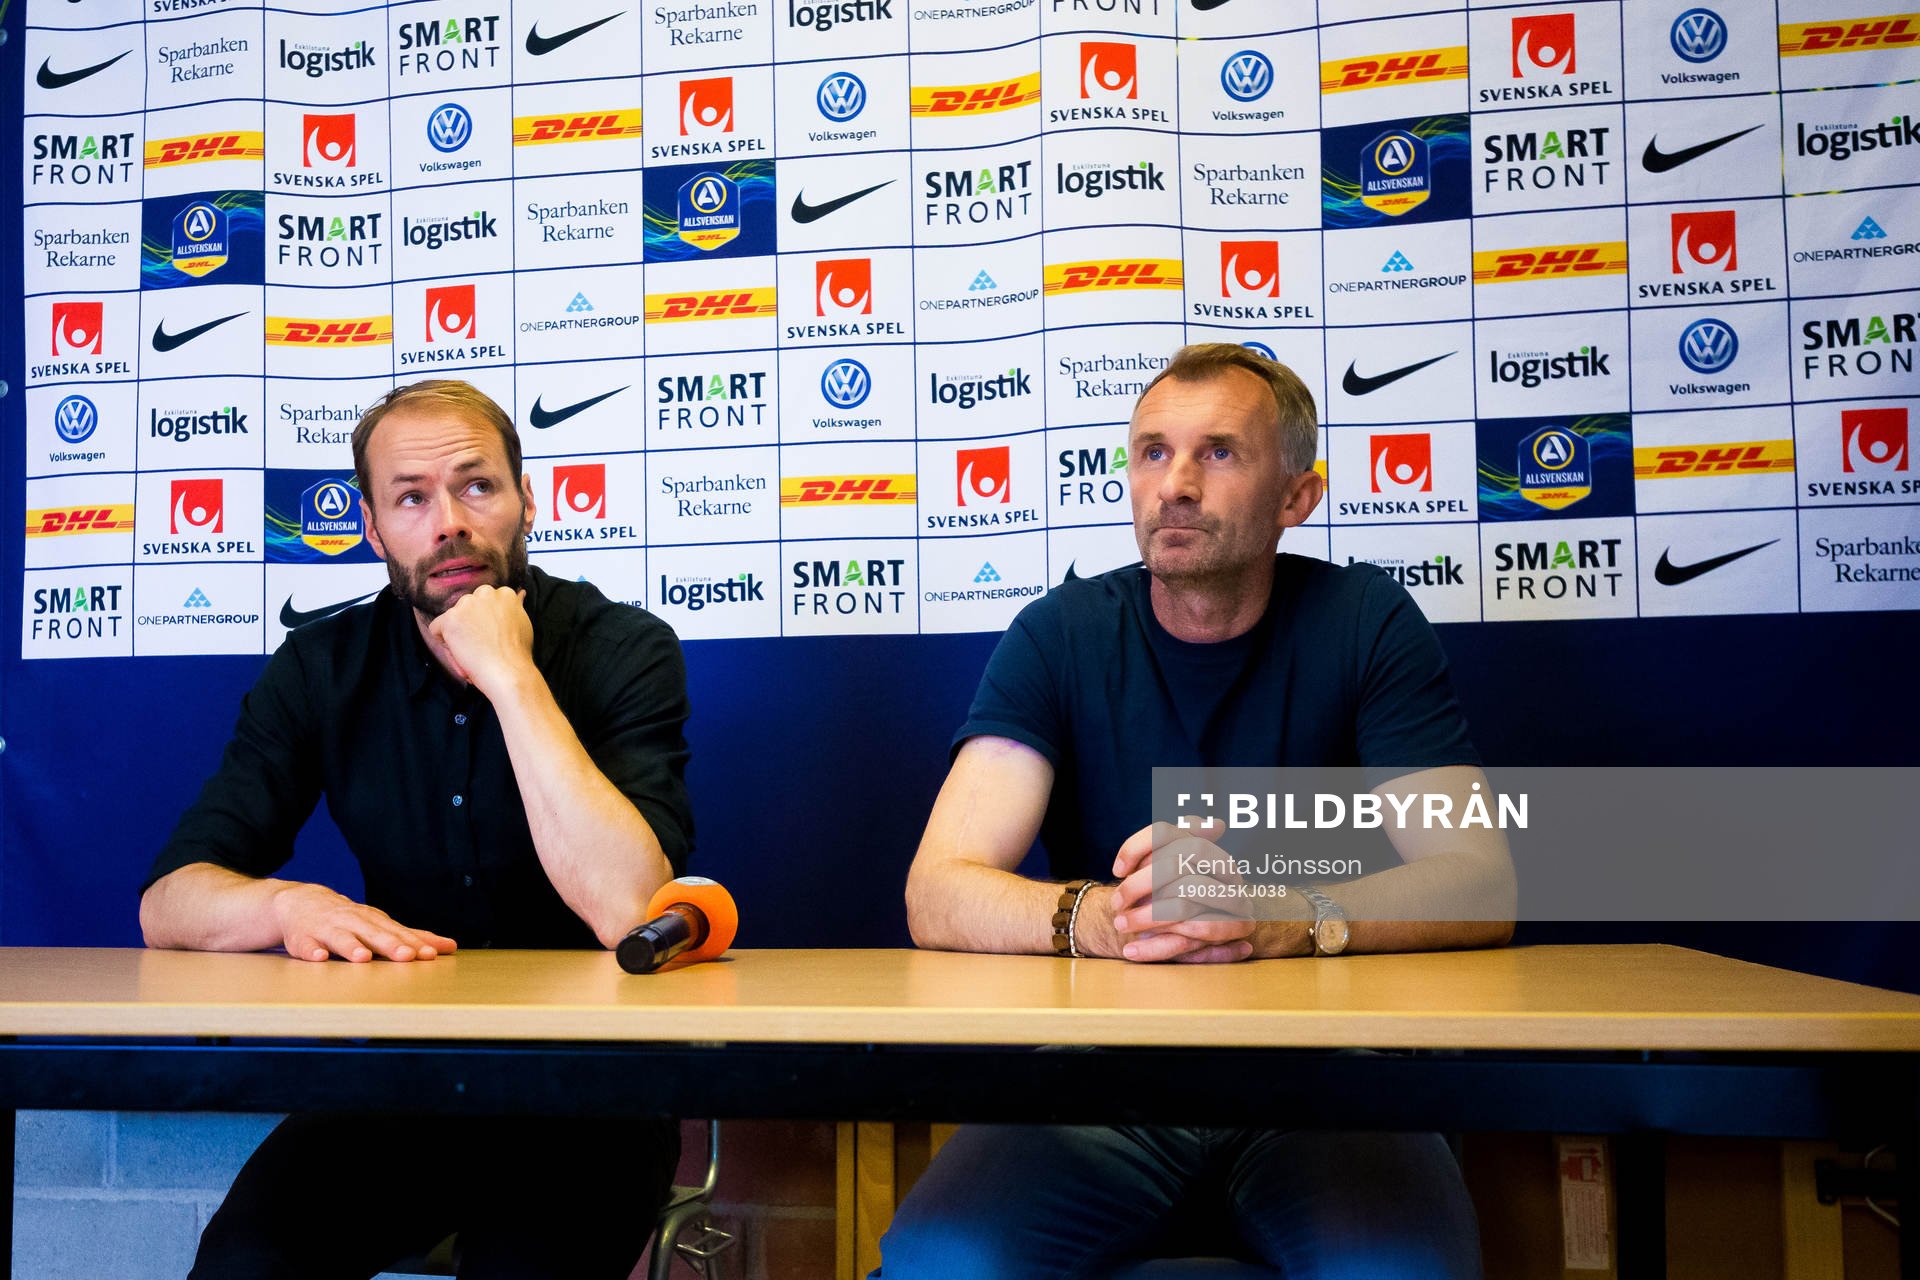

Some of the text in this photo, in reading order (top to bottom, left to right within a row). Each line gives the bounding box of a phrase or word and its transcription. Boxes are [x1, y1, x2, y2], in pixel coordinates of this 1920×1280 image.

[656, 2, 757, 28] Sparbanken
[399, 16, 499, 50] SMART
[671, 28, 742, 46] Rekarne
[1802, 20, 1917, 49] DHL
[159, 38, 247, 66] Sparbanken
[280, 39, 375, 77] logistik
[400, 47, 499, 76] FRONT
[171, 63, 233, 83] Rekarne
[1342, 55, 1445, 86] DHL
[1661, 73, 1740, 83] Volkswagen
[931, 84, 1024, 111] DHL
[1480, 81, 1612, 102] SVENSKA SPEL
[1051, 107, 1168, 122] SVENSKA SPEL
[1213, 111, 1284, 121] Volkswagen
[533, 116, 624, 140] DHL
[809, 131, 876, 141] Volkswagen
[1797, 115, 1920, 160] logistik
[34, 133, 134, 160] SMART
[159, 136, 245, 163] DHL
[652, 139, 765, 158] SVENSKA SPEL
[1484, 128, 1609, 163] SMART
[33, 162, 133, 184] FRONT
[420, 160, 481, 172] Volkswagen
[1194, 164, 1304, 186] Sparbanken
[274, 172, 383, 187] SVENSKA SPEL
[926, 161, 1032, 198] SMART
[1058, 162, 1165, 198] logistik
[1368, 176, 1424, 192] ALLSVENSKAN
[1486, 162, 1610, 193] FRONT
[1211, 188, 1288, 205] Rekarne
[528, 199, 628, 224] Sparbanken
[927, 191, 1031, 225] FRONT
[279, 213, 381, 241] SMART
[404, 211, 497, 249] logistik
[684, 214, 734, 228] ALLSVENSKAN
[35, 229, 129, 250] Sparbanken
[543, 225, 614, 242] Rekarne
[47, 251, 115, 267] Rekarne
[177, 242, 222, 256] ALLSVENSKAN
[279, 244, 382, 267] FRONT
[1496, 250, 1604, 277] DHL
[1063, 264, 1163, 288] DHL
[1330, 275, 1466, 292] ONEPARTNERGROUP
[1639, 278, 1776, 298] SVENSKA SPEL
[664, 294, 757, 318] DHL
[920, 289, 1038, 310] ONEPARTNERGROUP
[1194, 304, 1313, 318] SVENSKA SPEL
[284, 322, 377, 342] DHL
[520, 316, 639, 332] ONEPARTNERGROUP
[788, 323, 904, 338] SVENSKA SPEL
[401, 345, 505, 364] SVENSKA SPEL
[1059, 352, 1170, 379] Sparbanken
[1804, 349, 1913, 379] FRON
[32, 362, 130, 378] SVENSKA SPEL
[1491, 346, 1610, 388] logistik
[658, 372, 766, 403] SMART
[931, 368, 1031, 409] logistik
[1670, 384, 1750, 395] Volkswagen
[280, 403, 365, 423] Sparbank
[659, 404, 766, 430] FRONT
[813, 418, 881, 429] Volkswagen
[152, 407, 248, 442] logistik
[296, 427, 353, 445] Rekar
[50, 452, 105, 462] Volkswagen
[1059, 447, 1128, 477] SMA
[1657, 447, 1771, 473] DHL
[662, 474, 765, 498] Sparbanken
[1526, 472, 1584, 484] ALLSVENSKAN
[1808, 480, 1920, 496] SVENSKA SP
[800, 480, 896, 501] DHL
[1060, 481, 1123, 506] FRO
[679, 499, 751, 516] Rekarne
[928, 509, 1038, 528] SVENSKA SPEL
[1340, 500, 1468, 515] SVENSKA SPEL
[40, 510, 119, 532] DHL
[307, 520, 357, 531] ALLSVENSKAN
[600, 526, 636, 539] SPEL
[144, 542, 255, 555] SVENSKA SPEL
[1495, 539, 1621, 571] SMART
[793, 560, 904, 588] SMART
[662, 574, 764, 610] logistik
[925, 586, 1043, 601] ONEPARTNERGROUP
[1497, 573, 1622, 600] FRONT
[34, 585, 122, 614] SMART
[794, 592, 905, 615] FRONT
[33, 616, 122, 639] FRONT
[138, 615, 259, 625] ONEPARTNERGROUP
